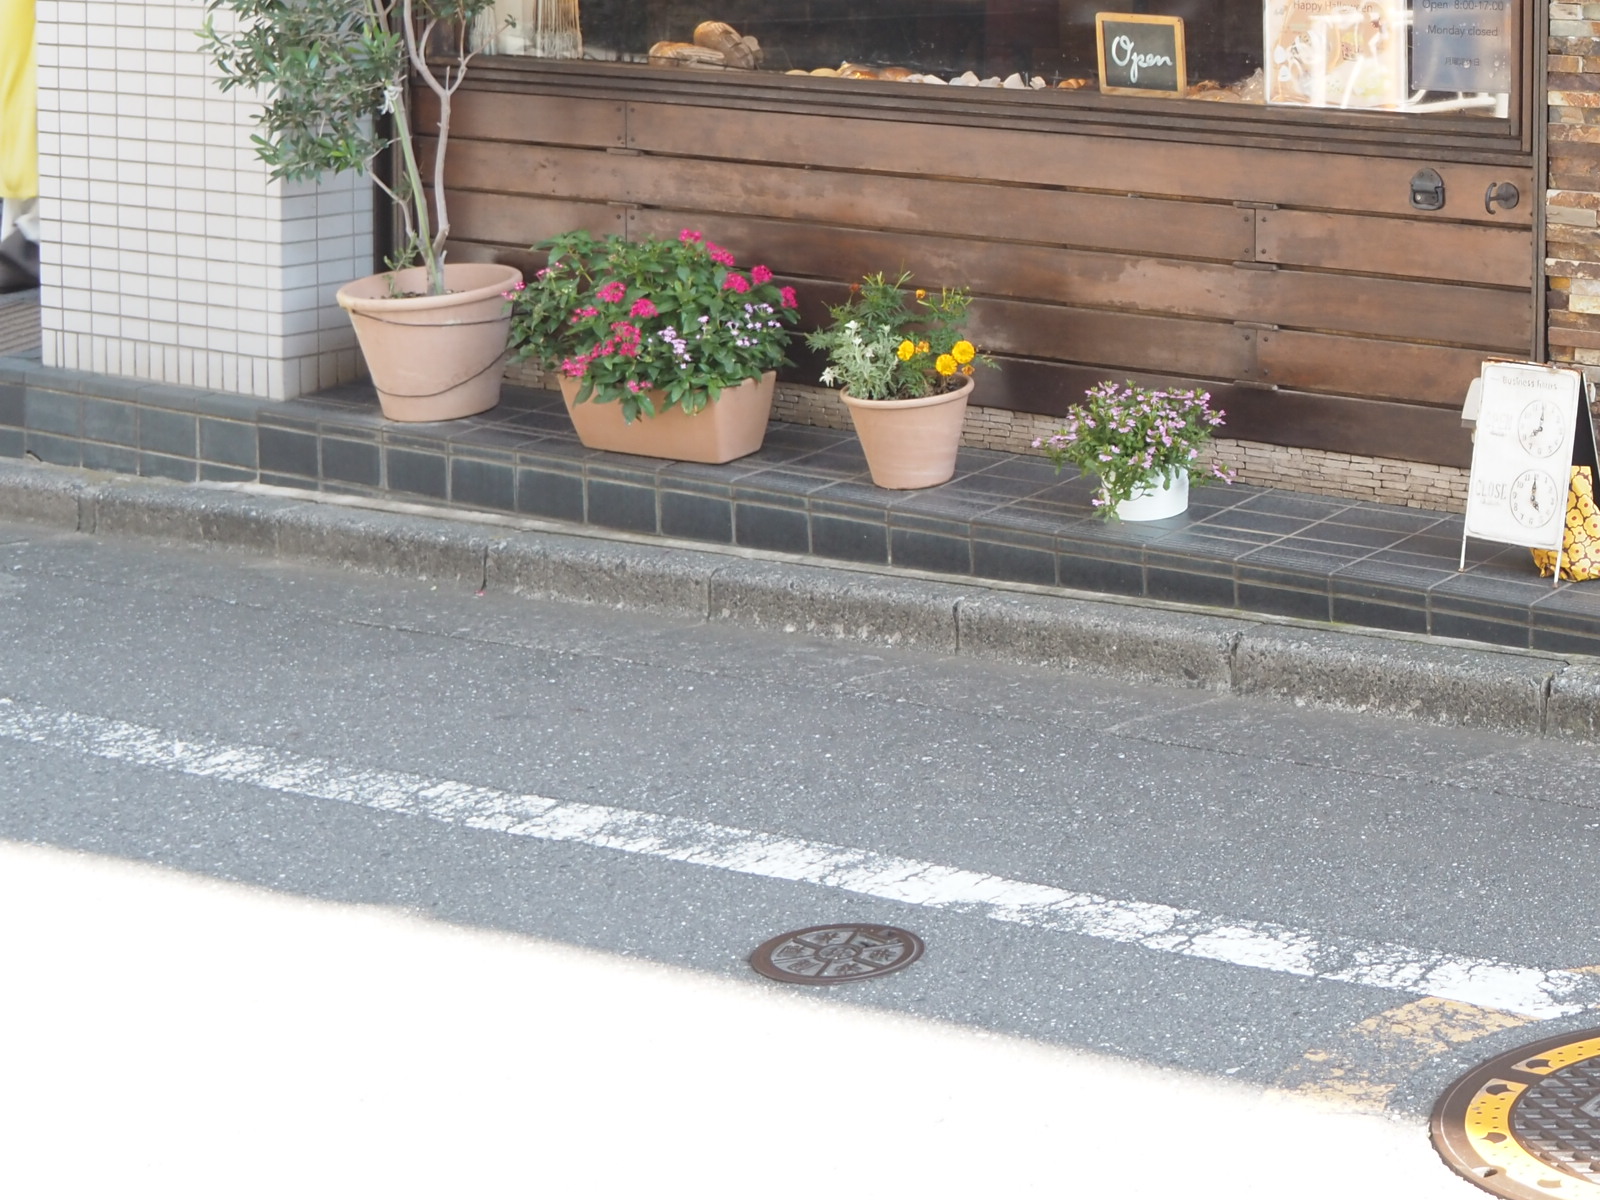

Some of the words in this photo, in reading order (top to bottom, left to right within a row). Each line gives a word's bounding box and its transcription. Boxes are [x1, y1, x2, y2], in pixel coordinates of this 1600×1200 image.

[1293, 0, 1322, 12] Happy
[1422, 0, 1449, 11] Open
[1453, 0, 1504, 11] 8:00-17:00
[1427, 24, 1465, 37] Monday
[1468, 25, 1498, 37] closed
[1111, 34, 1173, 84] Open
[1476, 480, 1507, 500] CLOSE
